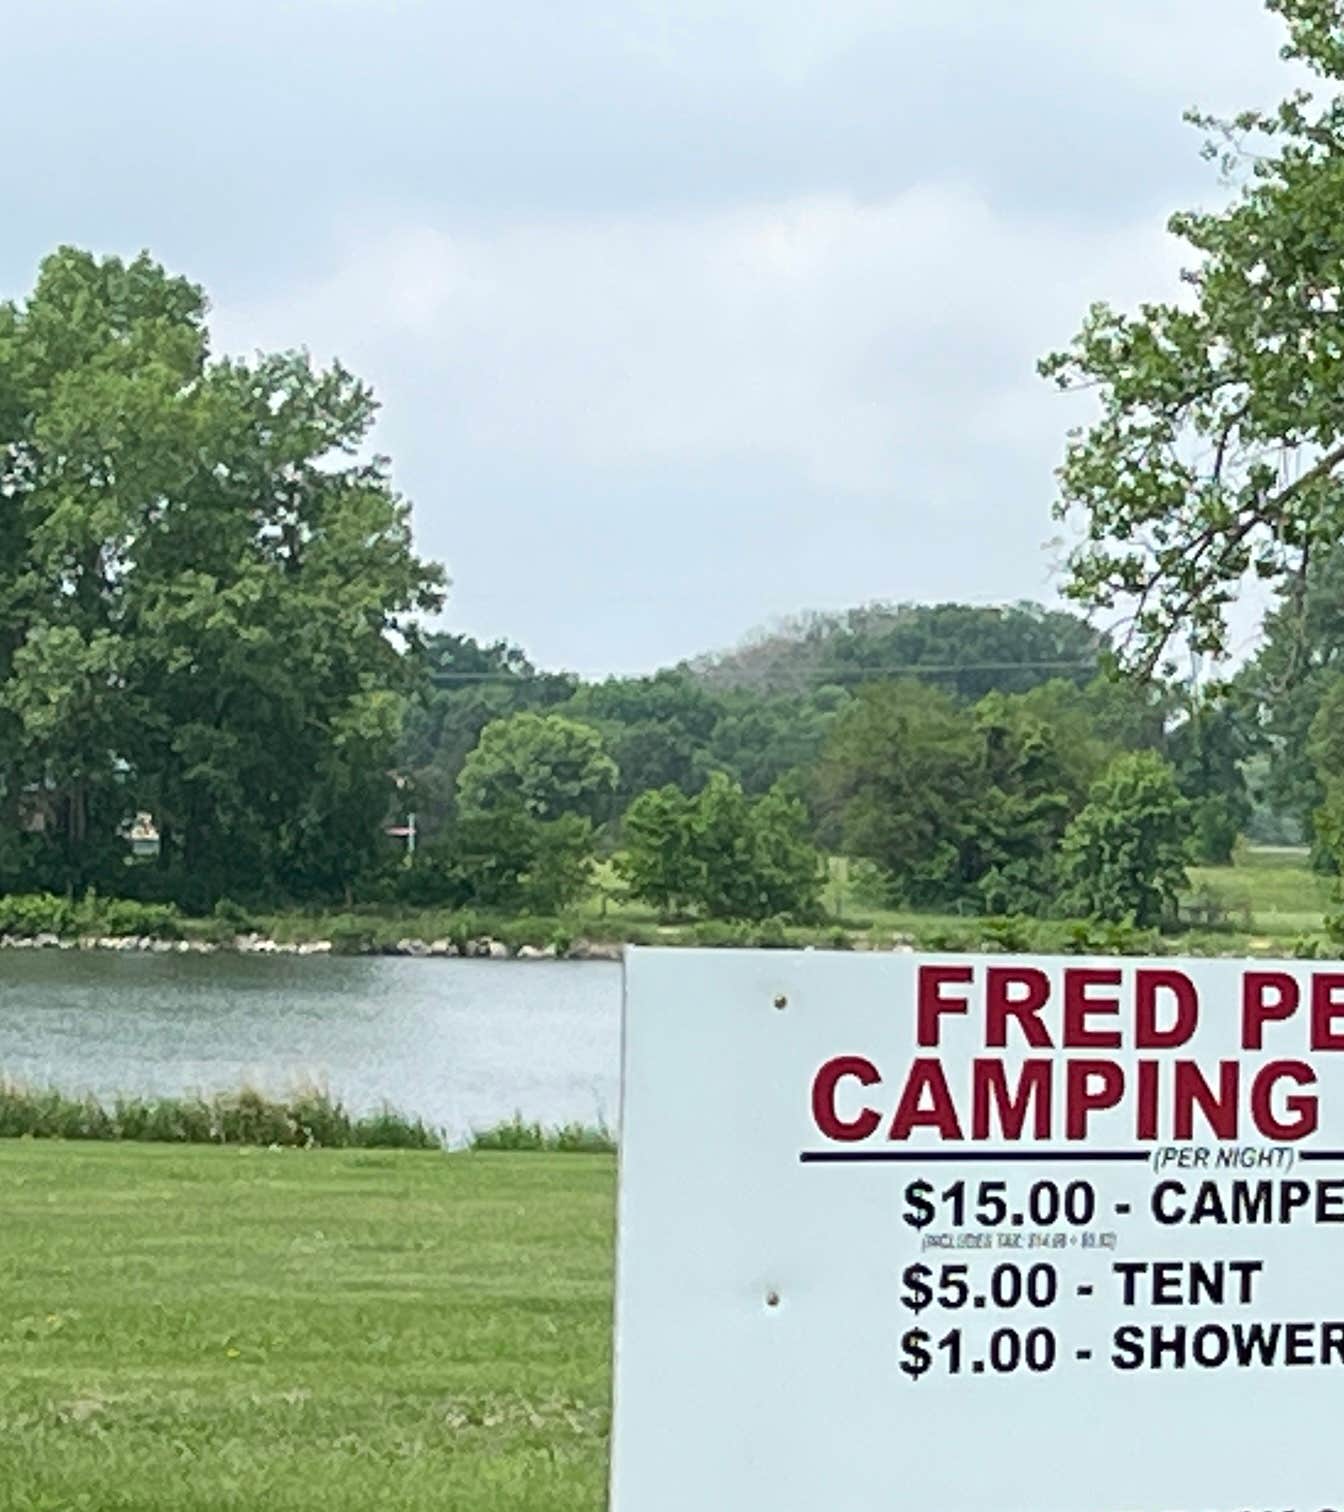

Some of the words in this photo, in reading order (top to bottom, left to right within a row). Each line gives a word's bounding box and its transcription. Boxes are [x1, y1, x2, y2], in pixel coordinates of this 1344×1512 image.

[917, 965, 1199, 1050] FRED
[811, 1055, 1319, 1143] CAMPING
[1153, 1147, 1211, 1174] (PER
[1215, 1146, 1294, 1173] NIGHT)
[902, 1178, 1095, 1231] $15.00
[1115, 1203, 1131, 1215] -
[900, 1262, 1057, 1313] $5.00
[1076, 1285, 1093, 1296] -
[1112, 1260, 1263, 1306] TENT
[899, 1326, 1056, 1381] $1.00
[1076, 1349, 1092, 1360] -
